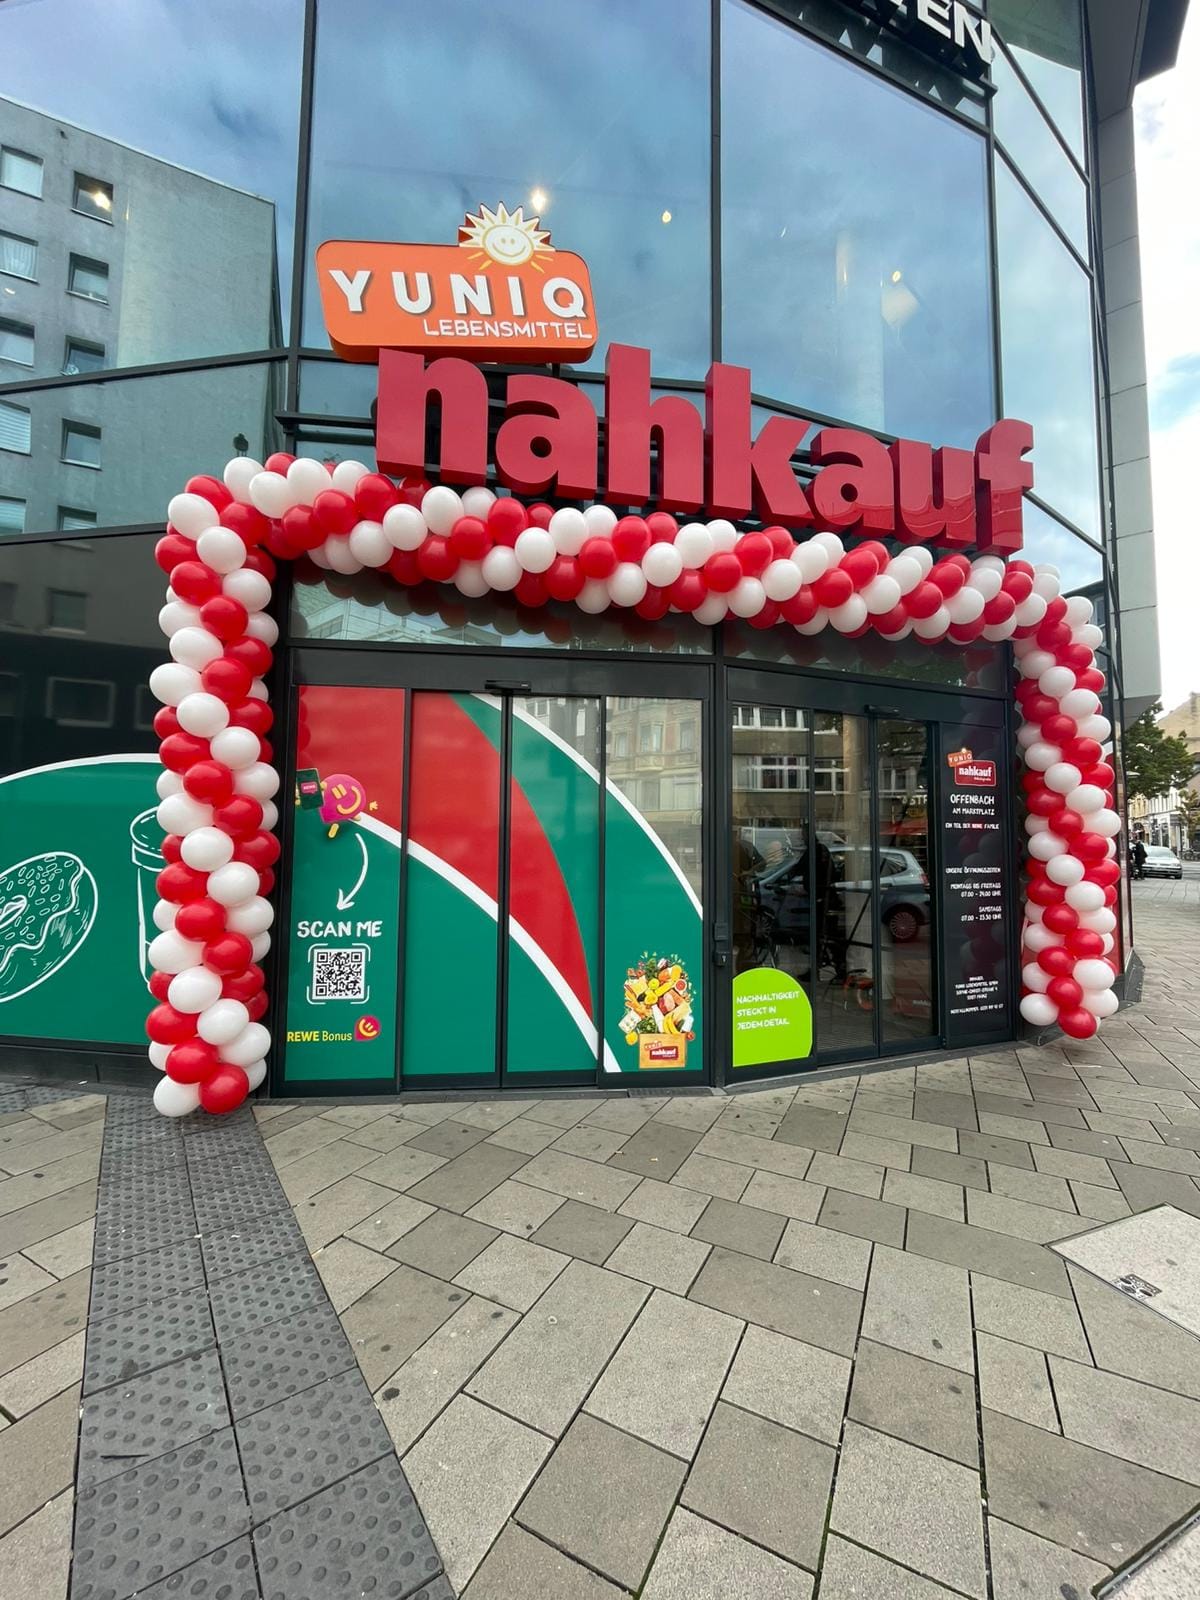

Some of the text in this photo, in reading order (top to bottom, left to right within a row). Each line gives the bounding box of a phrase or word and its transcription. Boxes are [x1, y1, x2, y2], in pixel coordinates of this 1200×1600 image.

[889, 0, 992, 65] EN
[328, 269, 587, 319] YUNIQ
[423, 318, 593, 339] LEBENSMITTEL
[376, 343, 1035, 555] nahkauf
[958, 765, 993, 778] nahkauf
[949, 794, 995, 805] OFFENBACH
[297, 920, 383, 938] SCAN ME
[736, 990, 800, 1004] NACHHALTIGKEIT
[736, 1006, 777, 1017] STECKT IN
[737, 1020, 763, 1031] JEDEM
[286, 1030, 353, 1042] REWE Bonus
